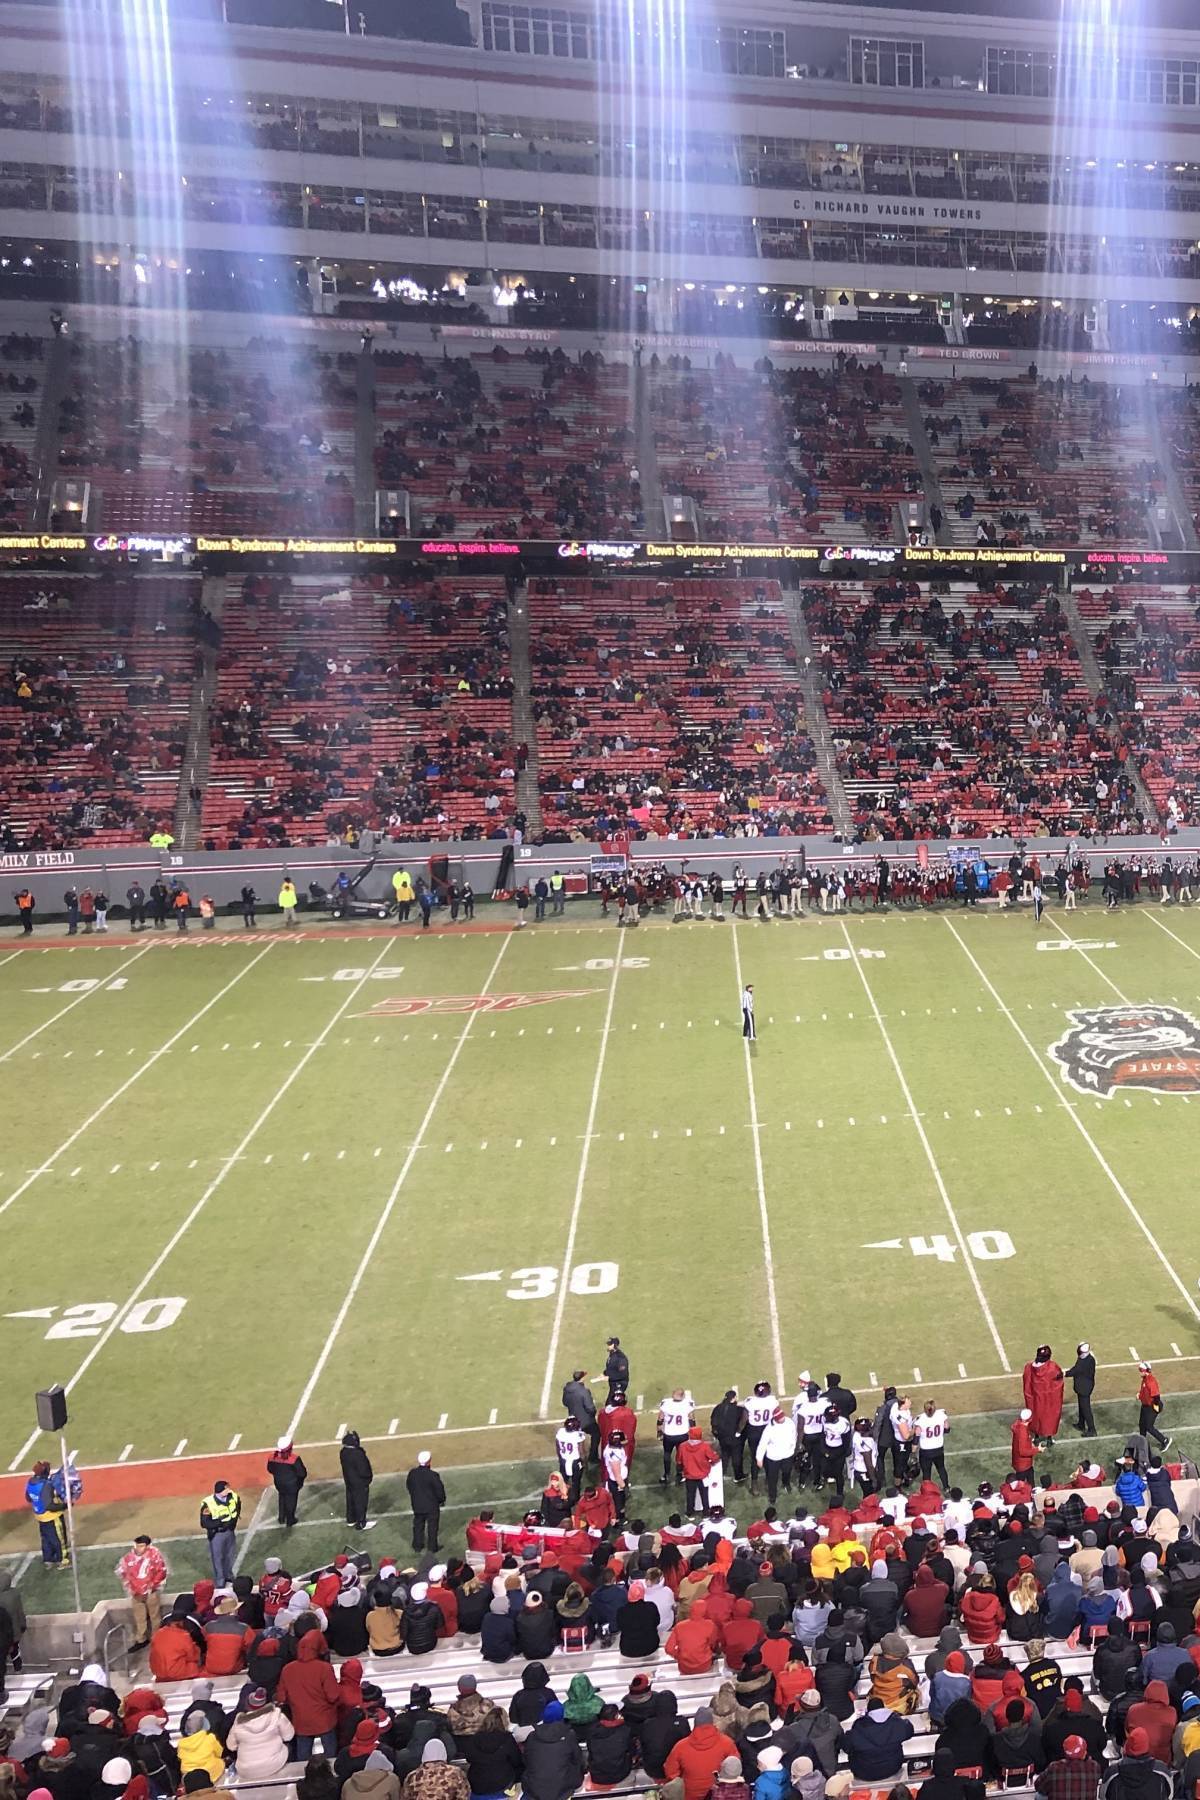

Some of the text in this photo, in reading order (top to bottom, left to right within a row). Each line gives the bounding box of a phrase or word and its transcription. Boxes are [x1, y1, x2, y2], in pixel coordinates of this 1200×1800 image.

[794, 200, 982, 219] C. RICHARD VAUGHN TOWERS
[472, 329, 516, 340] DENNIS
[795, 344, 821, 353] DICK
[940, 350, 1000, 361] TED BROWN
[41, 537, 86, 549] Centers
[197, 538, 396, 553] Down Syndrome Achievement Centers
[647, 545, 818, 559] Down Syndrome Achievement Centers
[906, 549, 1066, 562] Down Syndrome Achievement Centers
[36, 852, 74, 866] FIELD
[824, 947, 887, 961] 40
[584, 956, 652, 970] 30
[331, 966, 405, 981] 20
[57, 978, 129, 992] 10
[346, 988, 607, 1018] ACC
[1128, 1062, 1188, 1073] STATE
[908, 1230, 1017, 1263] 40
[506, 1261, 620, 1300] 30
[44, 1296, 189, 1340] 20
[754, 1409, 770, 1422] 50
[559, 1441, 574, 1454] 39
